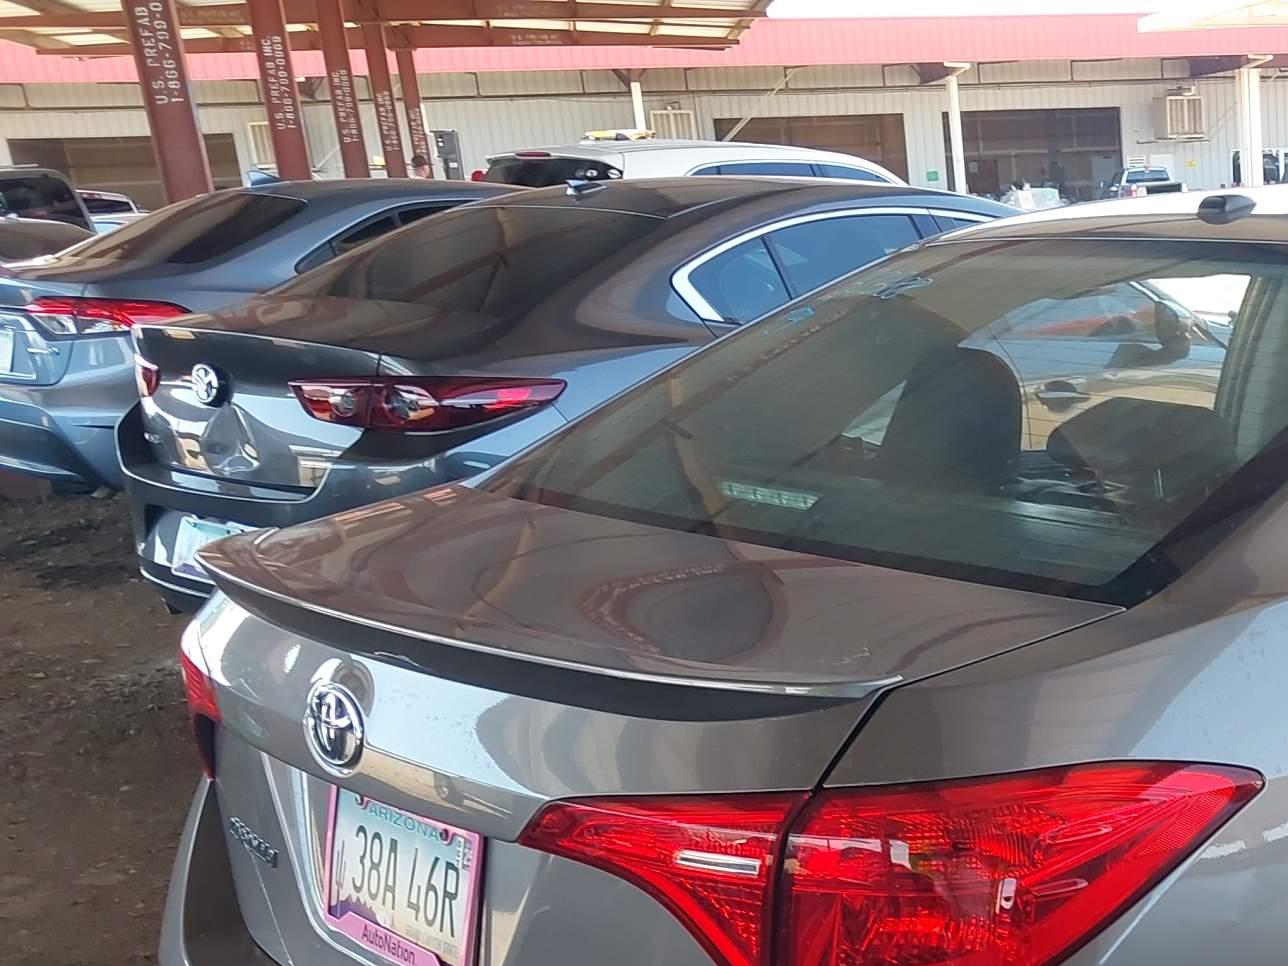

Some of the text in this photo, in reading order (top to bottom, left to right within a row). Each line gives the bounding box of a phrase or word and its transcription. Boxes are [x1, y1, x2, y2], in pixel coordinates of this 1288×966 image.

[134, 6, 169, 105] U.S. PREFAB
[368, 805, 440, 842] ARIZONA
[352, 825, 398, 911] 38A
[407, 847, 460, 938] 46R
[361, 924, 416, 966] AutoNation
